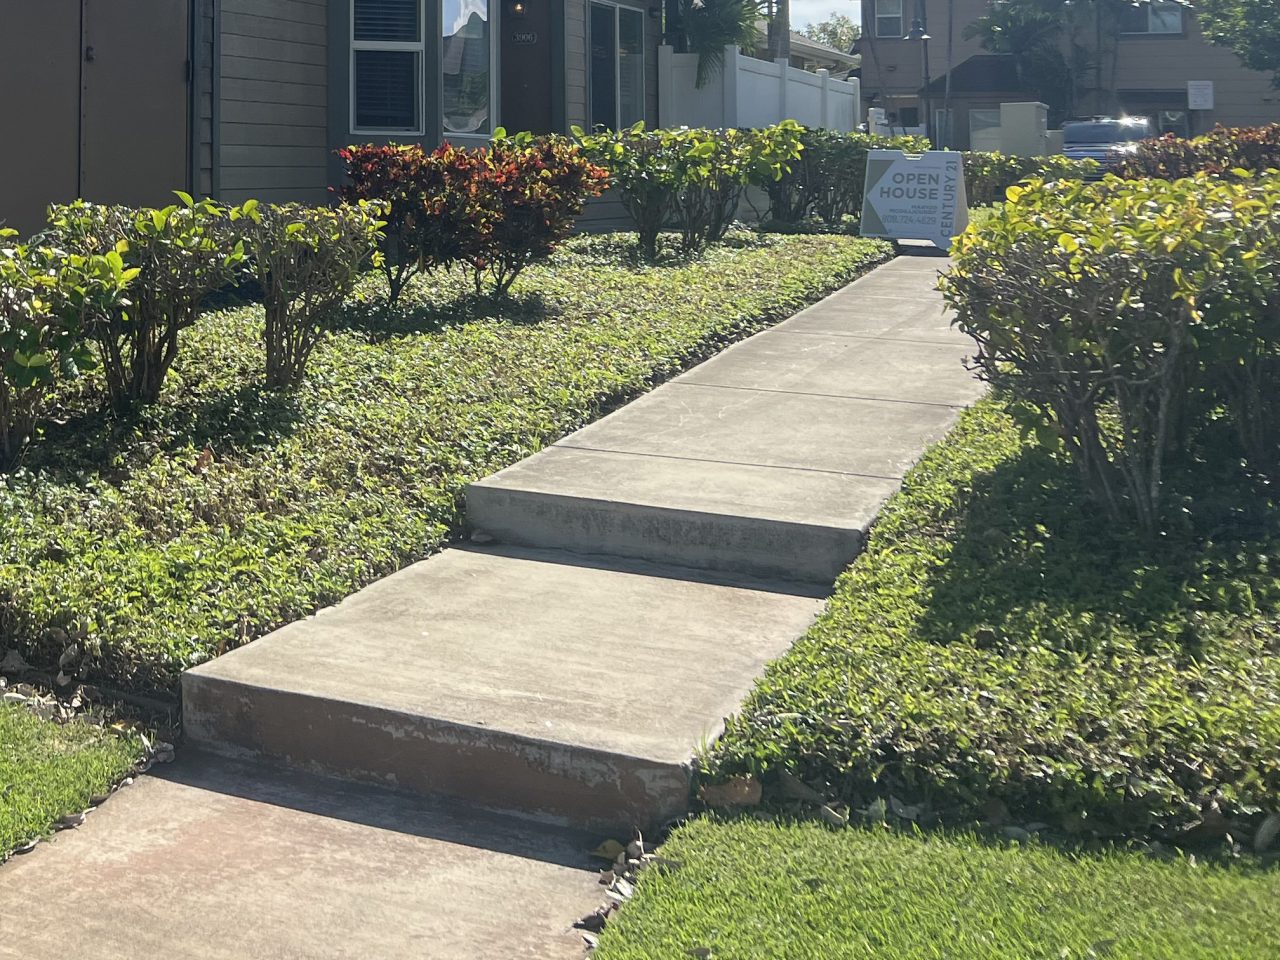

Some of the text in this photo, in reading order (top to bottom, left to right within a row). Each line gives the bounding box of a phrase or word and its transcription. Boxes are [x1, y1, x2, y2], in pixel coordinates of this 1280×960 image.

[892, 172, 939, 185] OPEN
[880, 186, 939, 200] HOUSE
[940, 160, 958, 237] CENTURY 21
